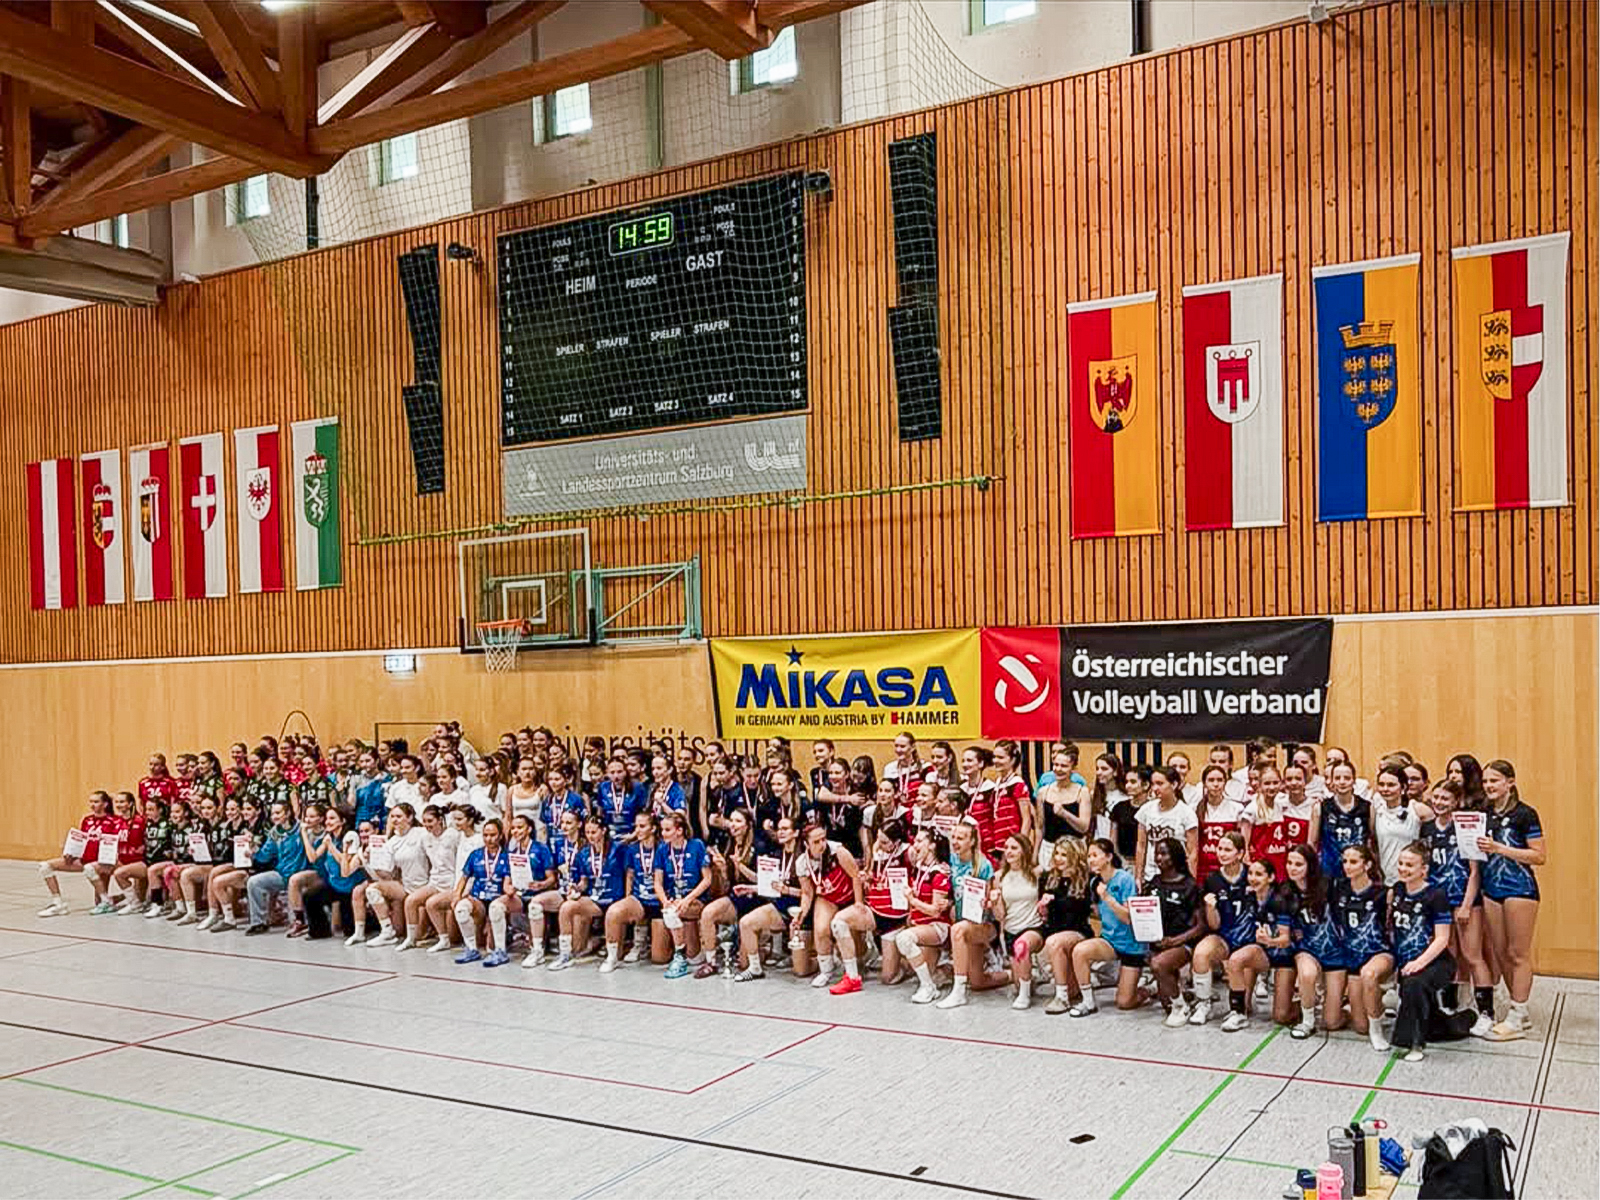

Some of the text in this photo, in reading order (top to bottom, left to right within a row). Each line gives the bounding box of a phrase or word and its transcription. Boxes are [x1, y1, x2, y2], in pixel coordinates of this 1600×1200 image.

[686, 250, 724, 272] GAST
[565, 274, 596, 296] HEIM
[626, 273, 658, 290] PERIODE
[651, 327, 682, 341] SPIELER
[693, 320, 730, 334] STRAFEN
[556, 343, 585, 356] SPIELER
[596, 336, 629, 350] STRAFEN
[707, 393, 727, 404] SATZ
[609, 407, 627, 418] SATZ
[654, 402, 673, 413] SATZ
[560, 414, 577, 425] SATZ
[673, 443, 696, 462] und
[561, 464, 735, 495] Landessportzentrum Salzburg
[1072, 649, 1288, 678] Österreichischer
[735, 663, 959, 708] MIKASA
[1072, 687, 1321, 719] Volleyball Verband
[735, 711, 959, 726] IN GERMANY AND AUSTRIA BY HAMMER
[1204, 825, 1224, 840] 13
[1273, 825, 1284, 840] 4
[1288, 821, 1301, 837] 9
[1232, 900, 1242, 917] 7
[1348, 912, 1358, 928] 6
